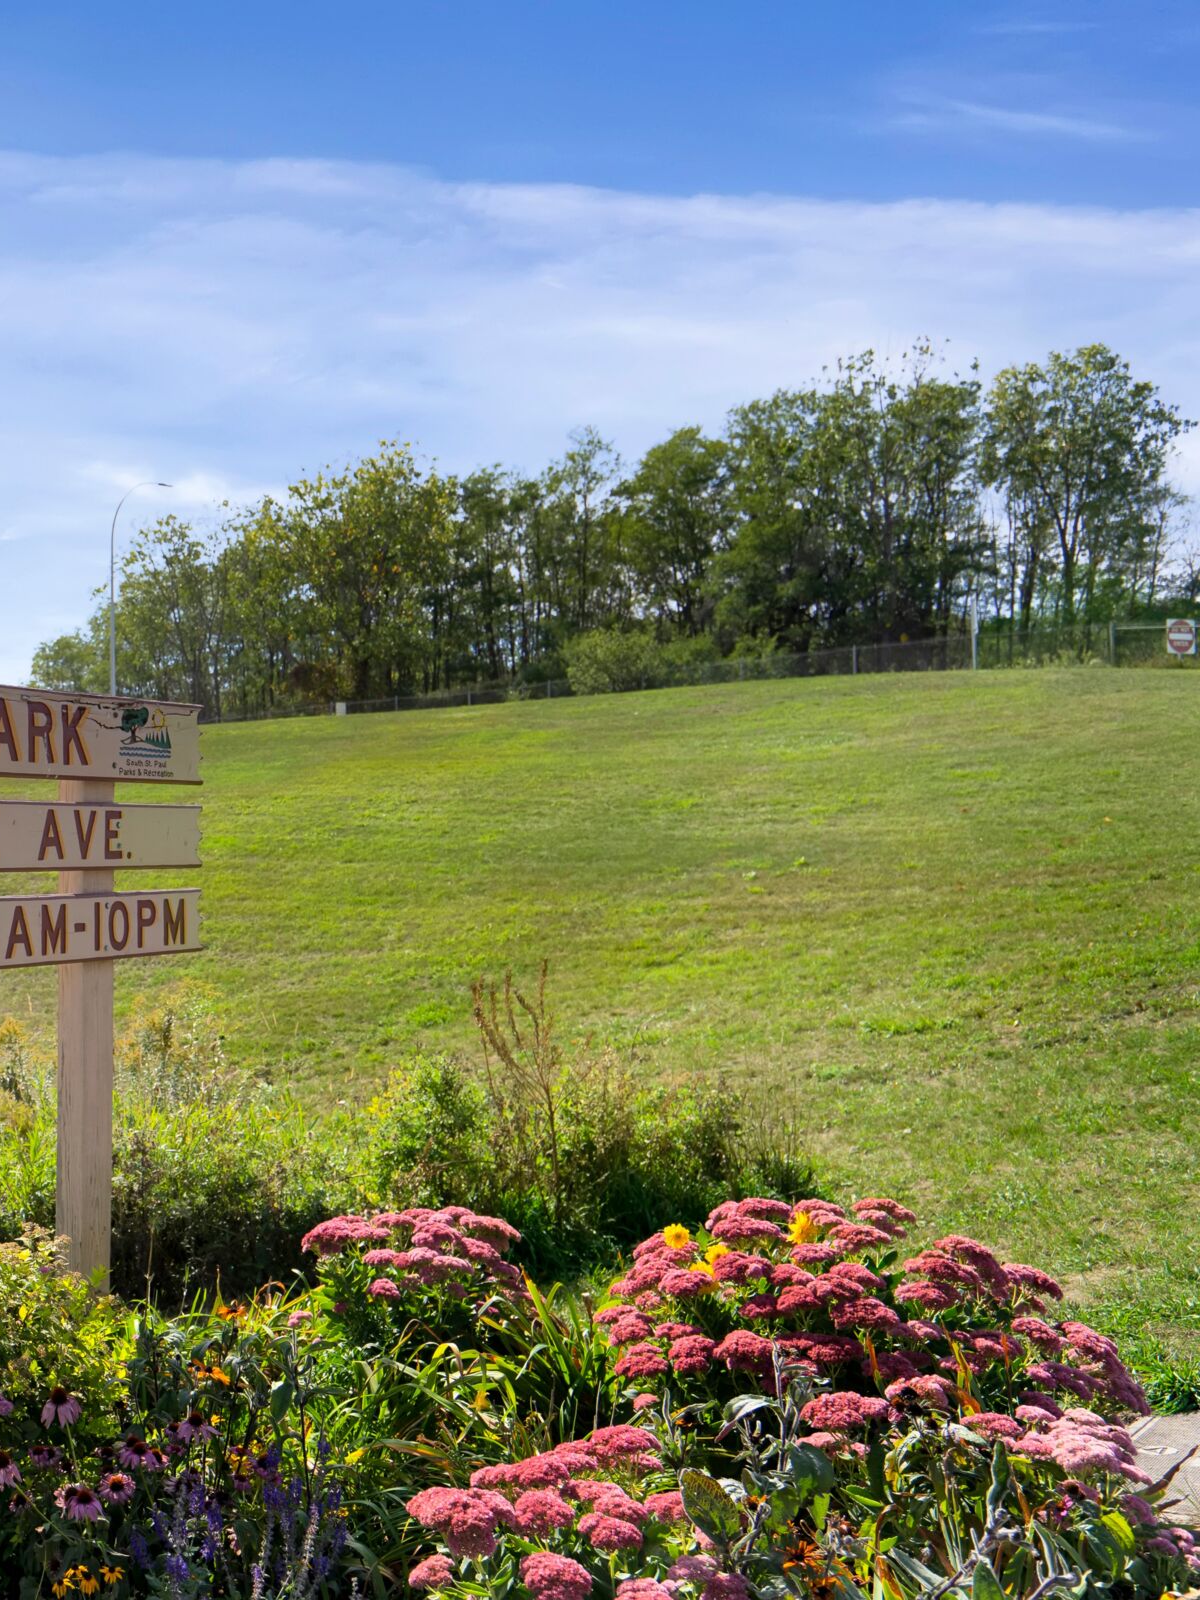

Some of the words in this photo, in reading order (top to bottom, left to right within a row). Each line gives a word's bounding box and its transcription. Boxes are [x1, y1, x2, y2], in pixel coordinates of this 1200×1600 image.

[126, 758, 143, 767] South
[154, 760, 167, 768] Paul
[119, 767, 136, 776] Parks
[144, 769, 174, 777] Recreation
[38, 809, 132, 861] AVE.
